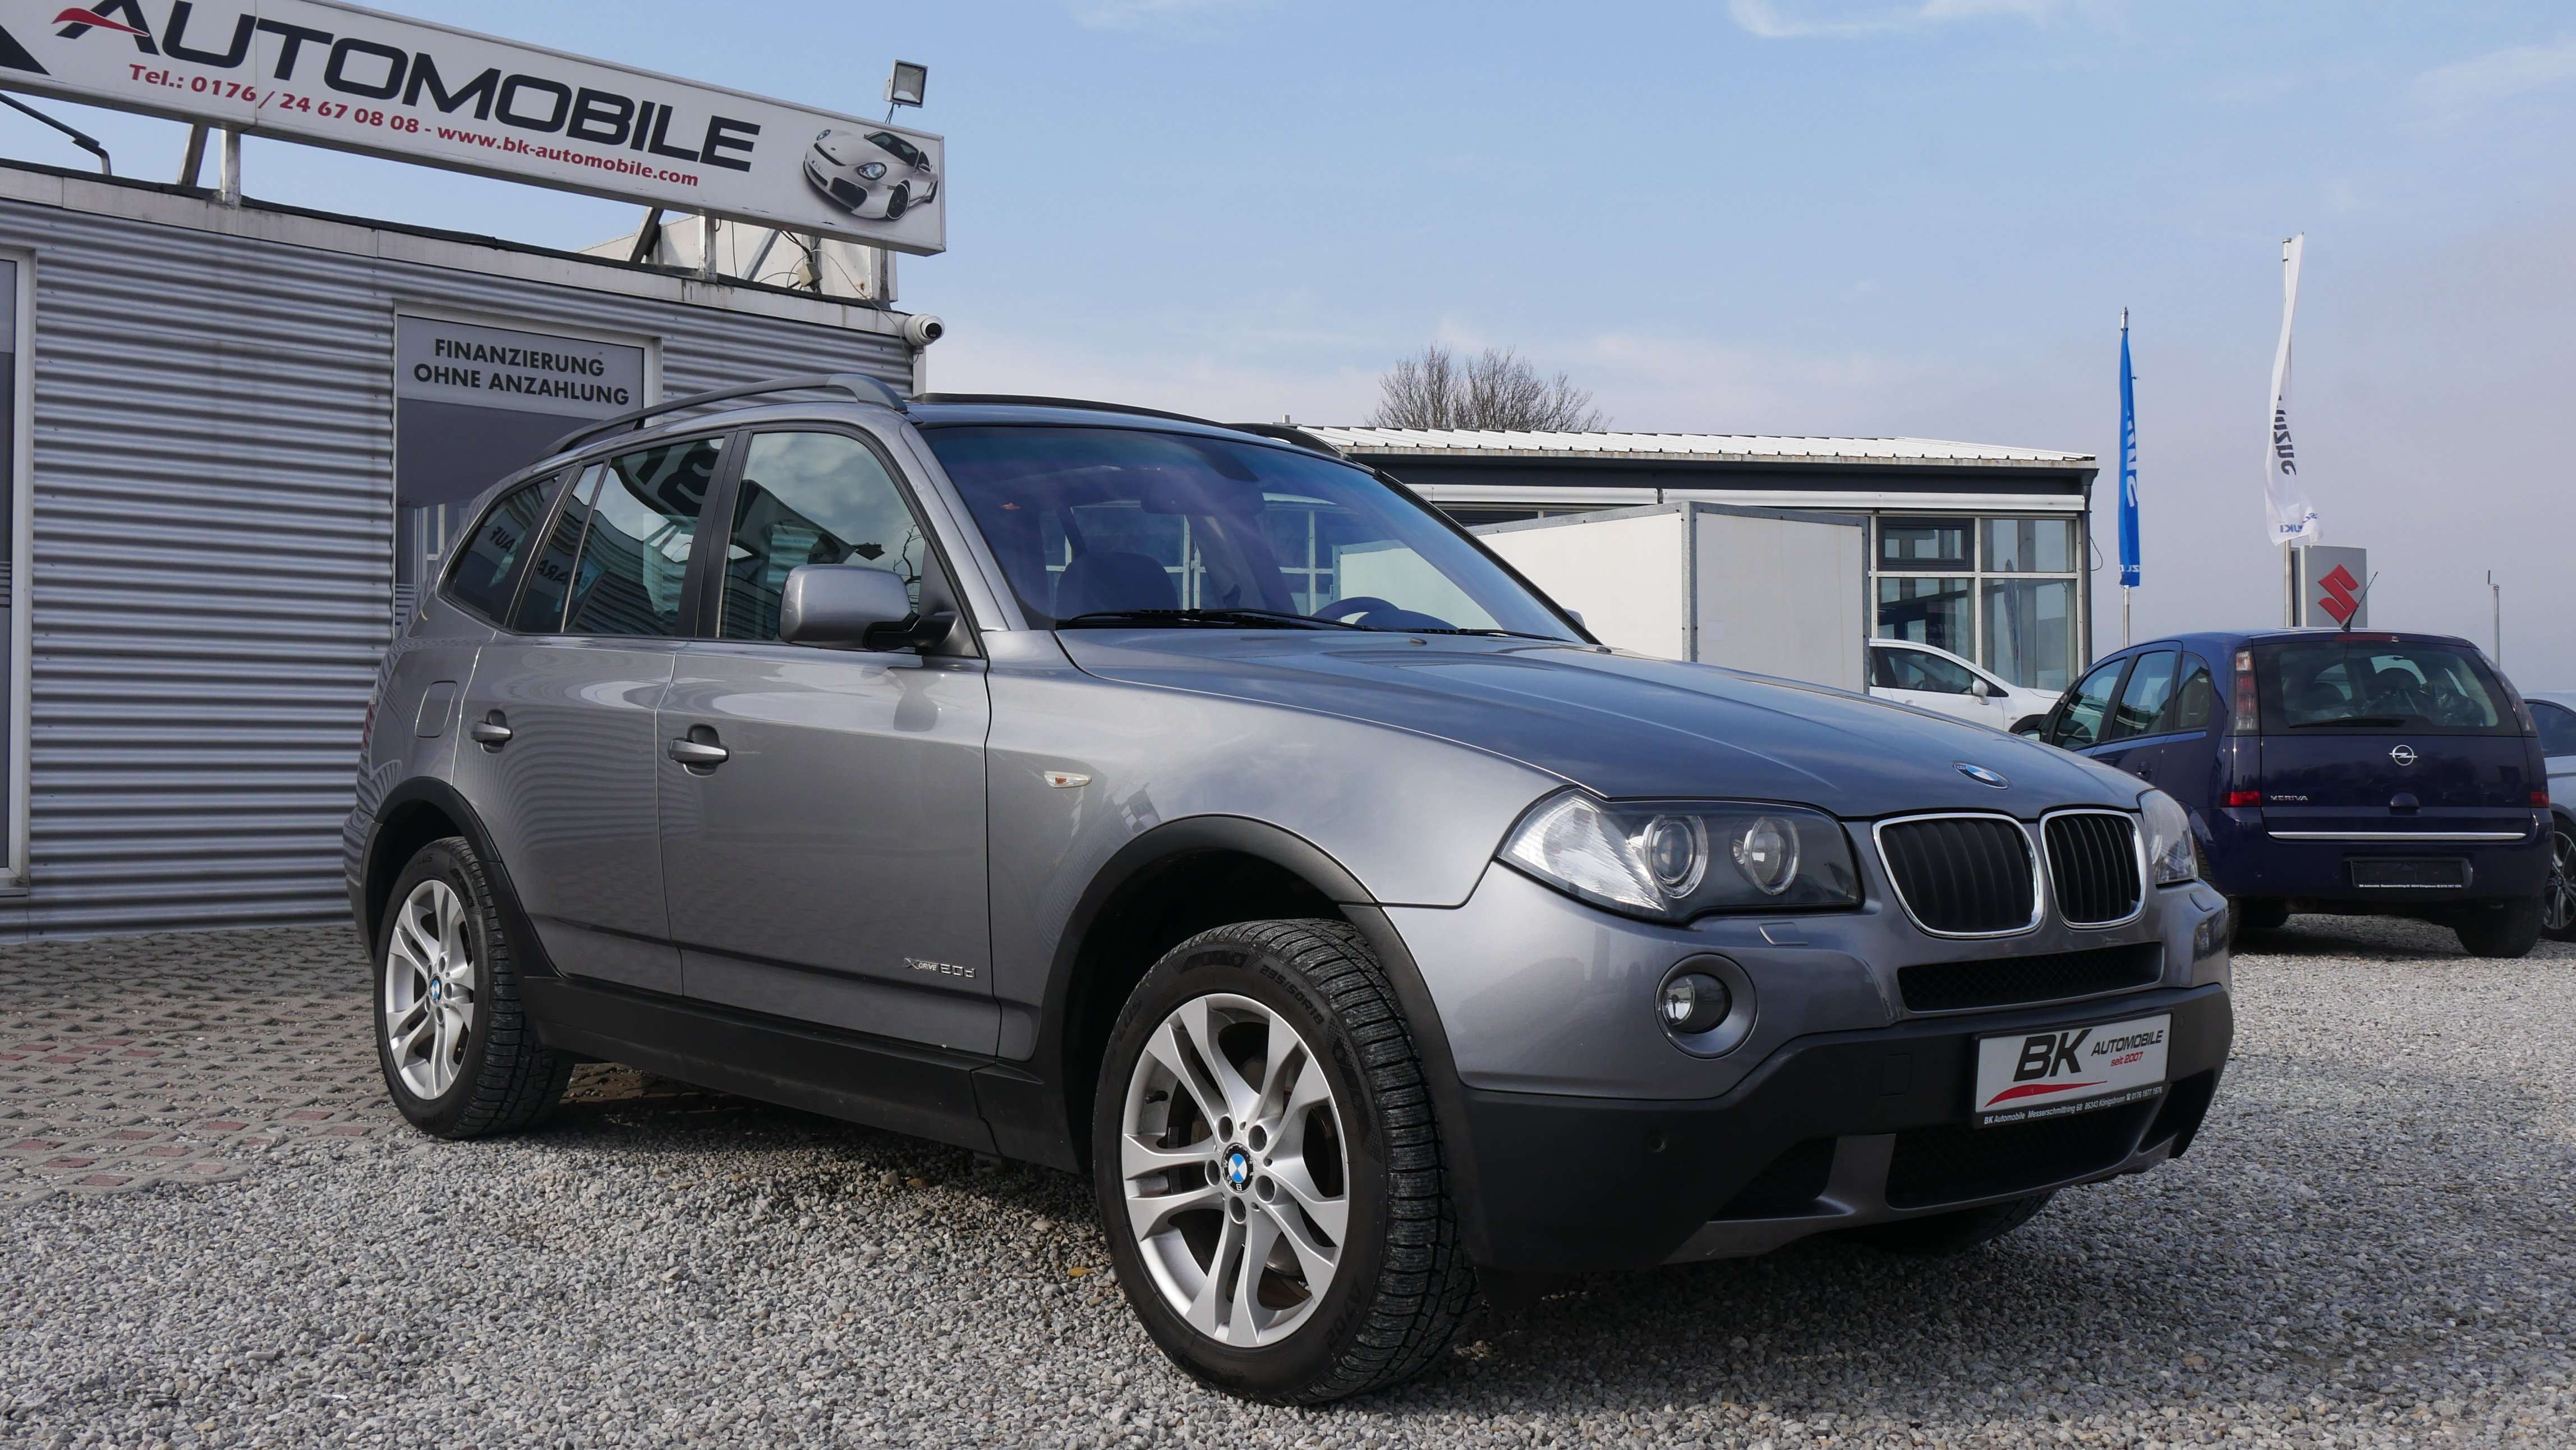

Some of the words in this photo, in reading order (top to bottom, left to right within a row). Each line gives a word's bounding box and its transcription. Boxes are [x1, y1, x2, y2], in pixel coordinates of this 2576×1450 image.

[55, 0, 761, 172] AUTOMOBILE
[130, 63, 184, 89] Tel.:
[191, 76, 256, 102] 0176
[279, 93, 311, 112] 24
[318, 101, 348, 119] 67
[355, 108, 384, 127] 08
[390, 115, 419, 133] 08
[438, 127, 701, 185] www.bk-automobile.com
[435, 338, 604, 377] FINANZIERUNG
[414, 363, 481, 388] OHNE
[488, 373, 629, 405] ANZAHLUNG
[2013, 1028, 2093, 1082] BK
[2091, 1030, 2164, 1056] AUTOMOBILE
[2110, 1056, 2124, 1066] seit
[2124, 1051, 2144, 1064] 2007
[1984, 1116, 1993, 1125] BK
[1994, 1111, 2026, 1123] Automobile
[2028, 1104, 2076, 1118] Messerschmittring
